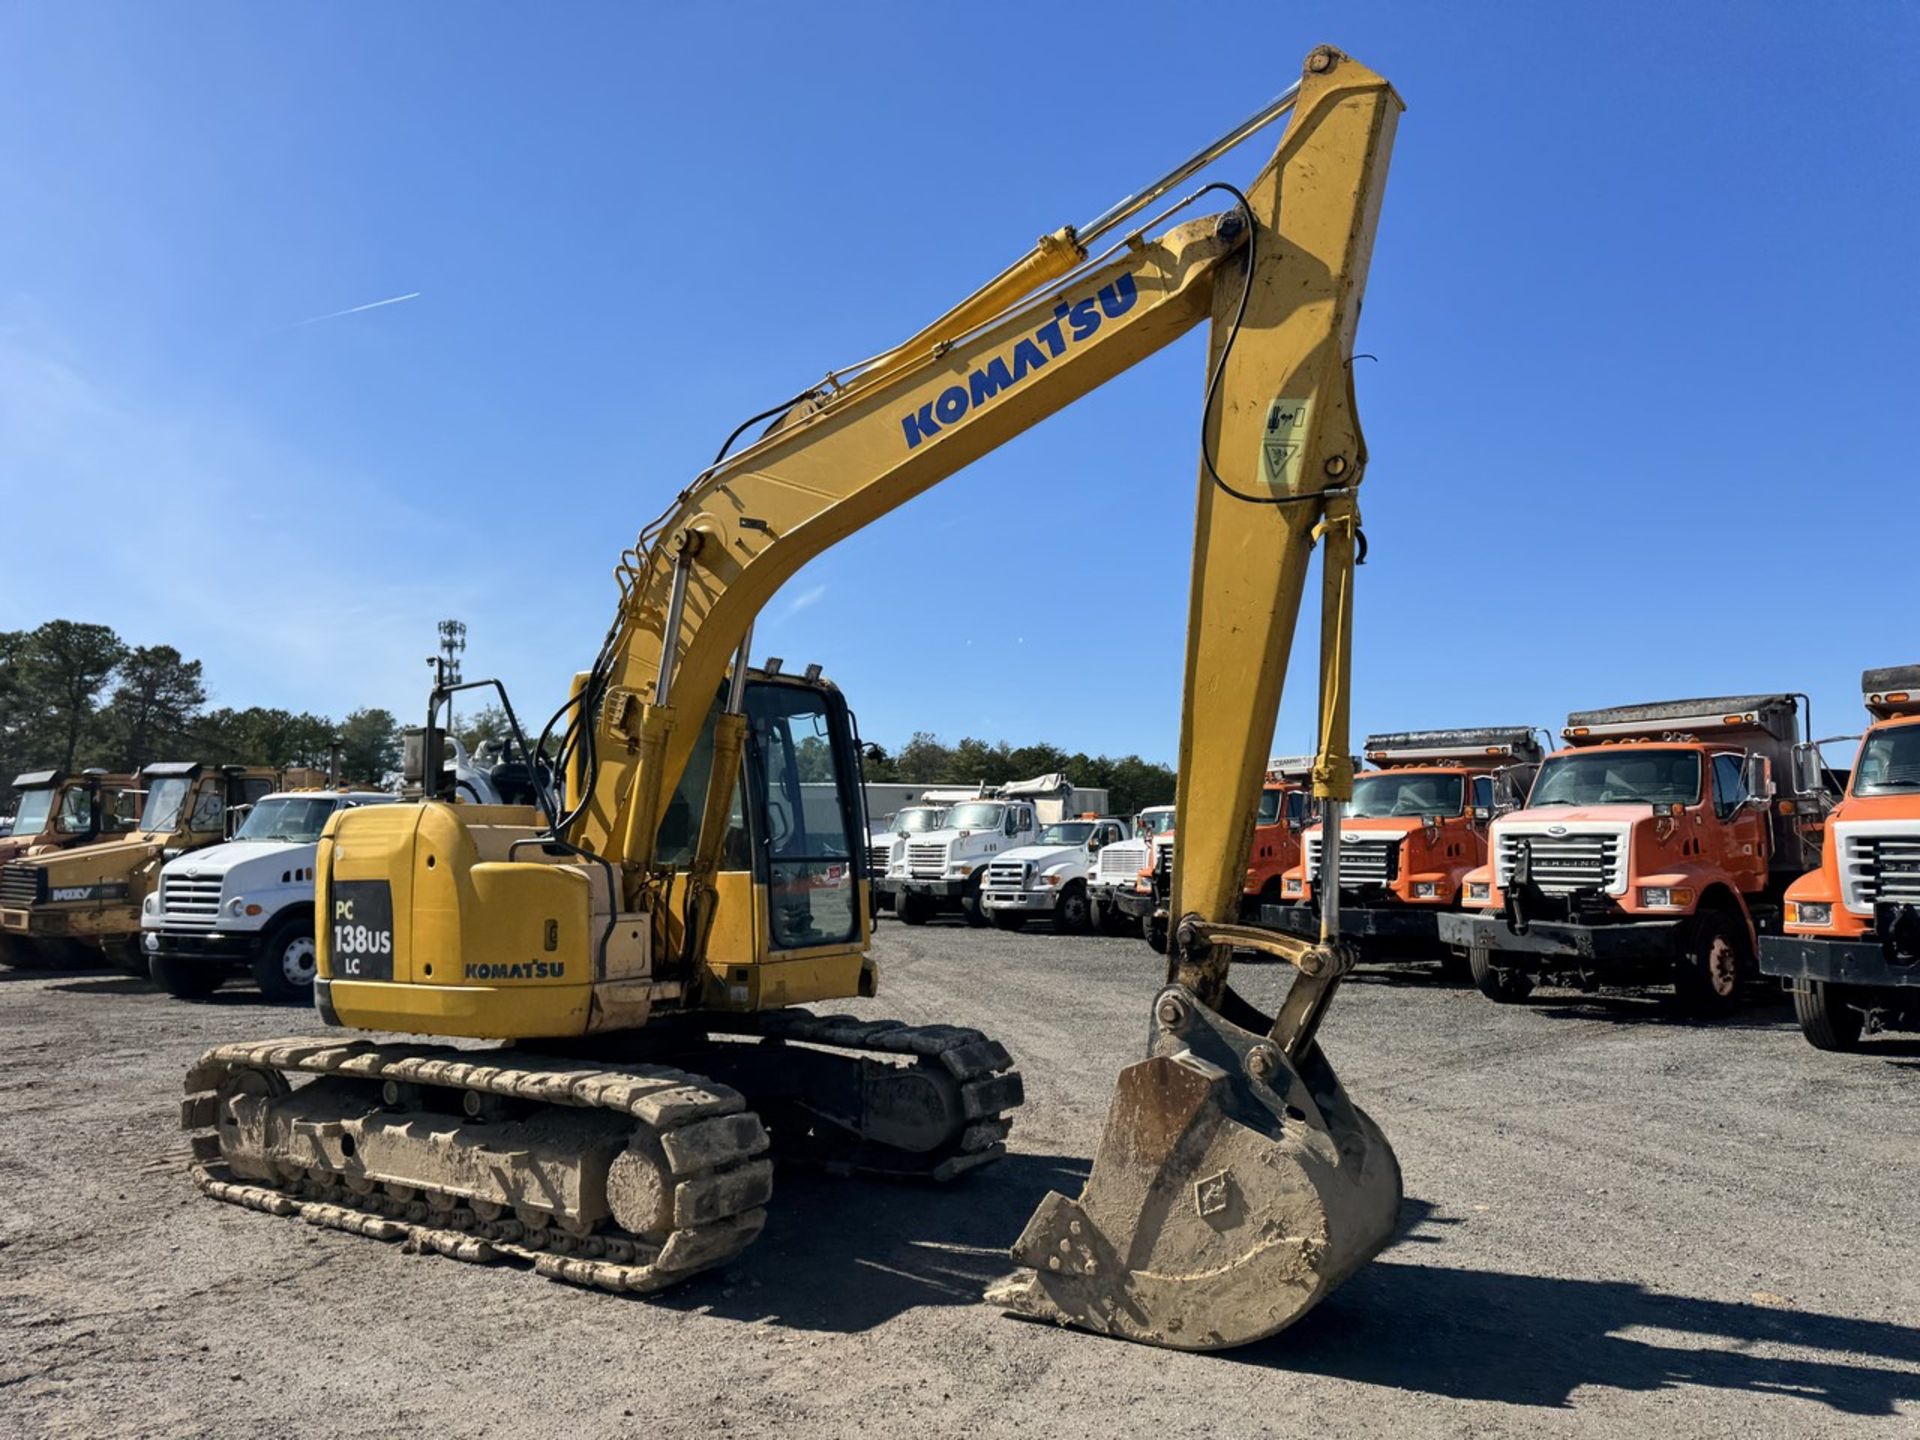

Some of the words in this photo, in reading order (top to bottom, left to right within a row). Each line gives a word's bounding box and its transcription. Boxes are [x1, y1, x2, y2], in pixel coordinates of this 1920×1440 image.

[901, 271, 1138, 449] KOMATSU
[53, 887, 92, 902] MOXY
[335, 900, 354, 920] PC
[334, 924, 391, 954] 138US
[345, 958, 360, 975] LC
[465, 959, 564, 979] KOMATSU
